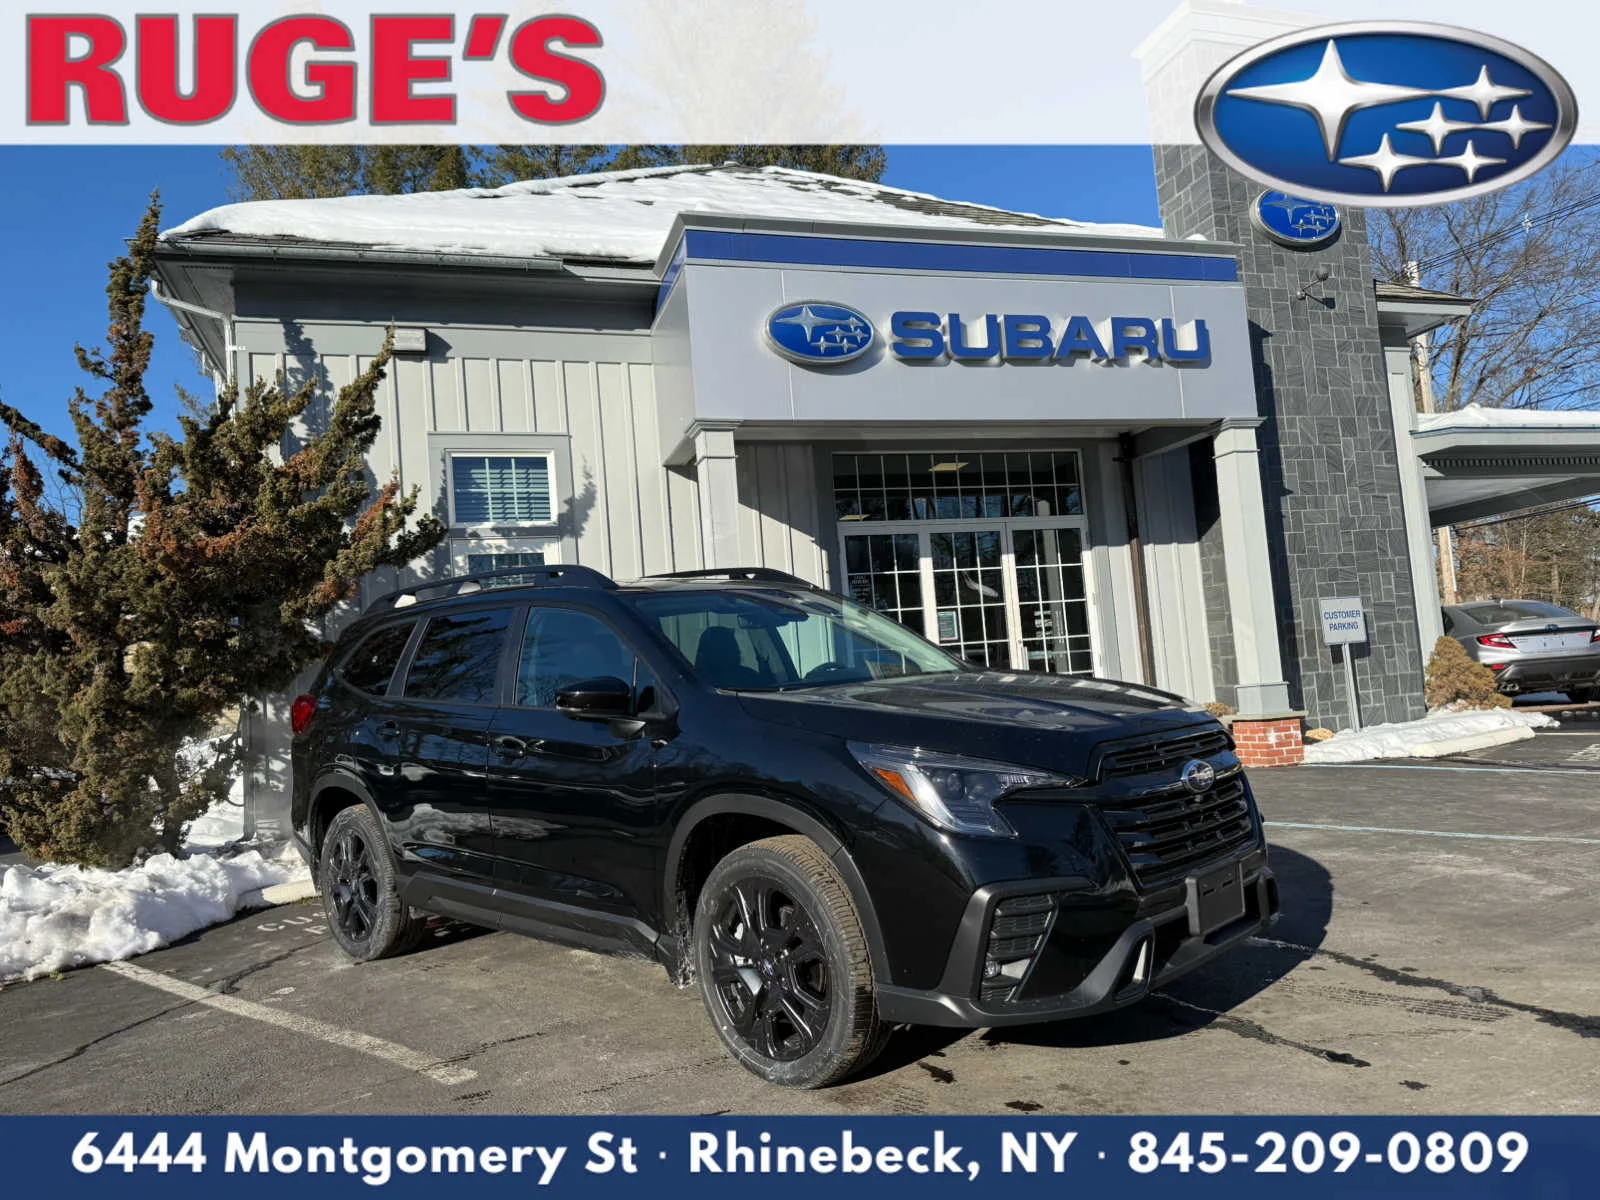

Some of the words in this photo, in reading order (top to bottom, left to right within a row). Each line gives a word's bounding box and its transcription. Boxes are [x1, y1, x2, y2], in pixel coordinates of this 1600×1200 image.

[890, 310, 1210, 362] SUBARU
[1323, 610, 1361, 620] CUSTOMER
[1329, 621, 1359, 631] PARKING
